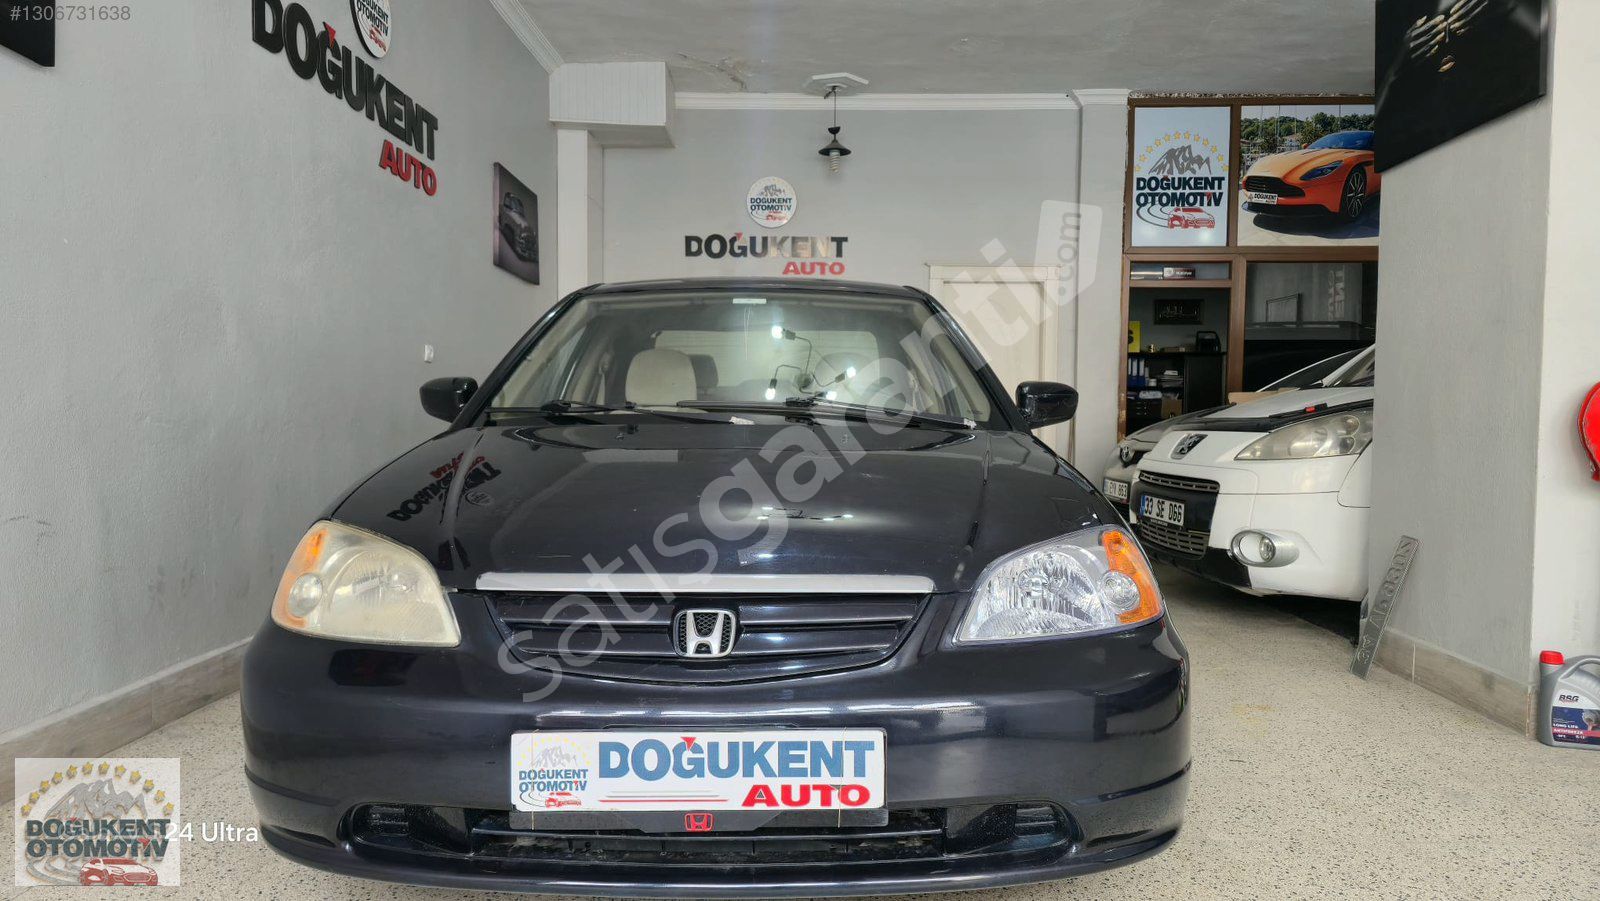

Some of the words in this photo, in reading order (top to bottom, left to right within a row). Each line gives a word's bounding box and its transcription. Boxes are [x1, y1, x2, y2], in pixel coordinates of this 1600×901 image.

[379, 139, 438, 197] AUTO
[1136, 175, 1225, 192] DOĞUKENT
[684, 232, 848, 259] DOĞUKENT
[782, 261, 845, 276] AUTO
[1144, 497, 1154, 516] 33
[1156, 499, 1165, 519] SE
[598, 736, 875, 782] DOĞUKENT
[741, 784, 871, 808] AUTO
